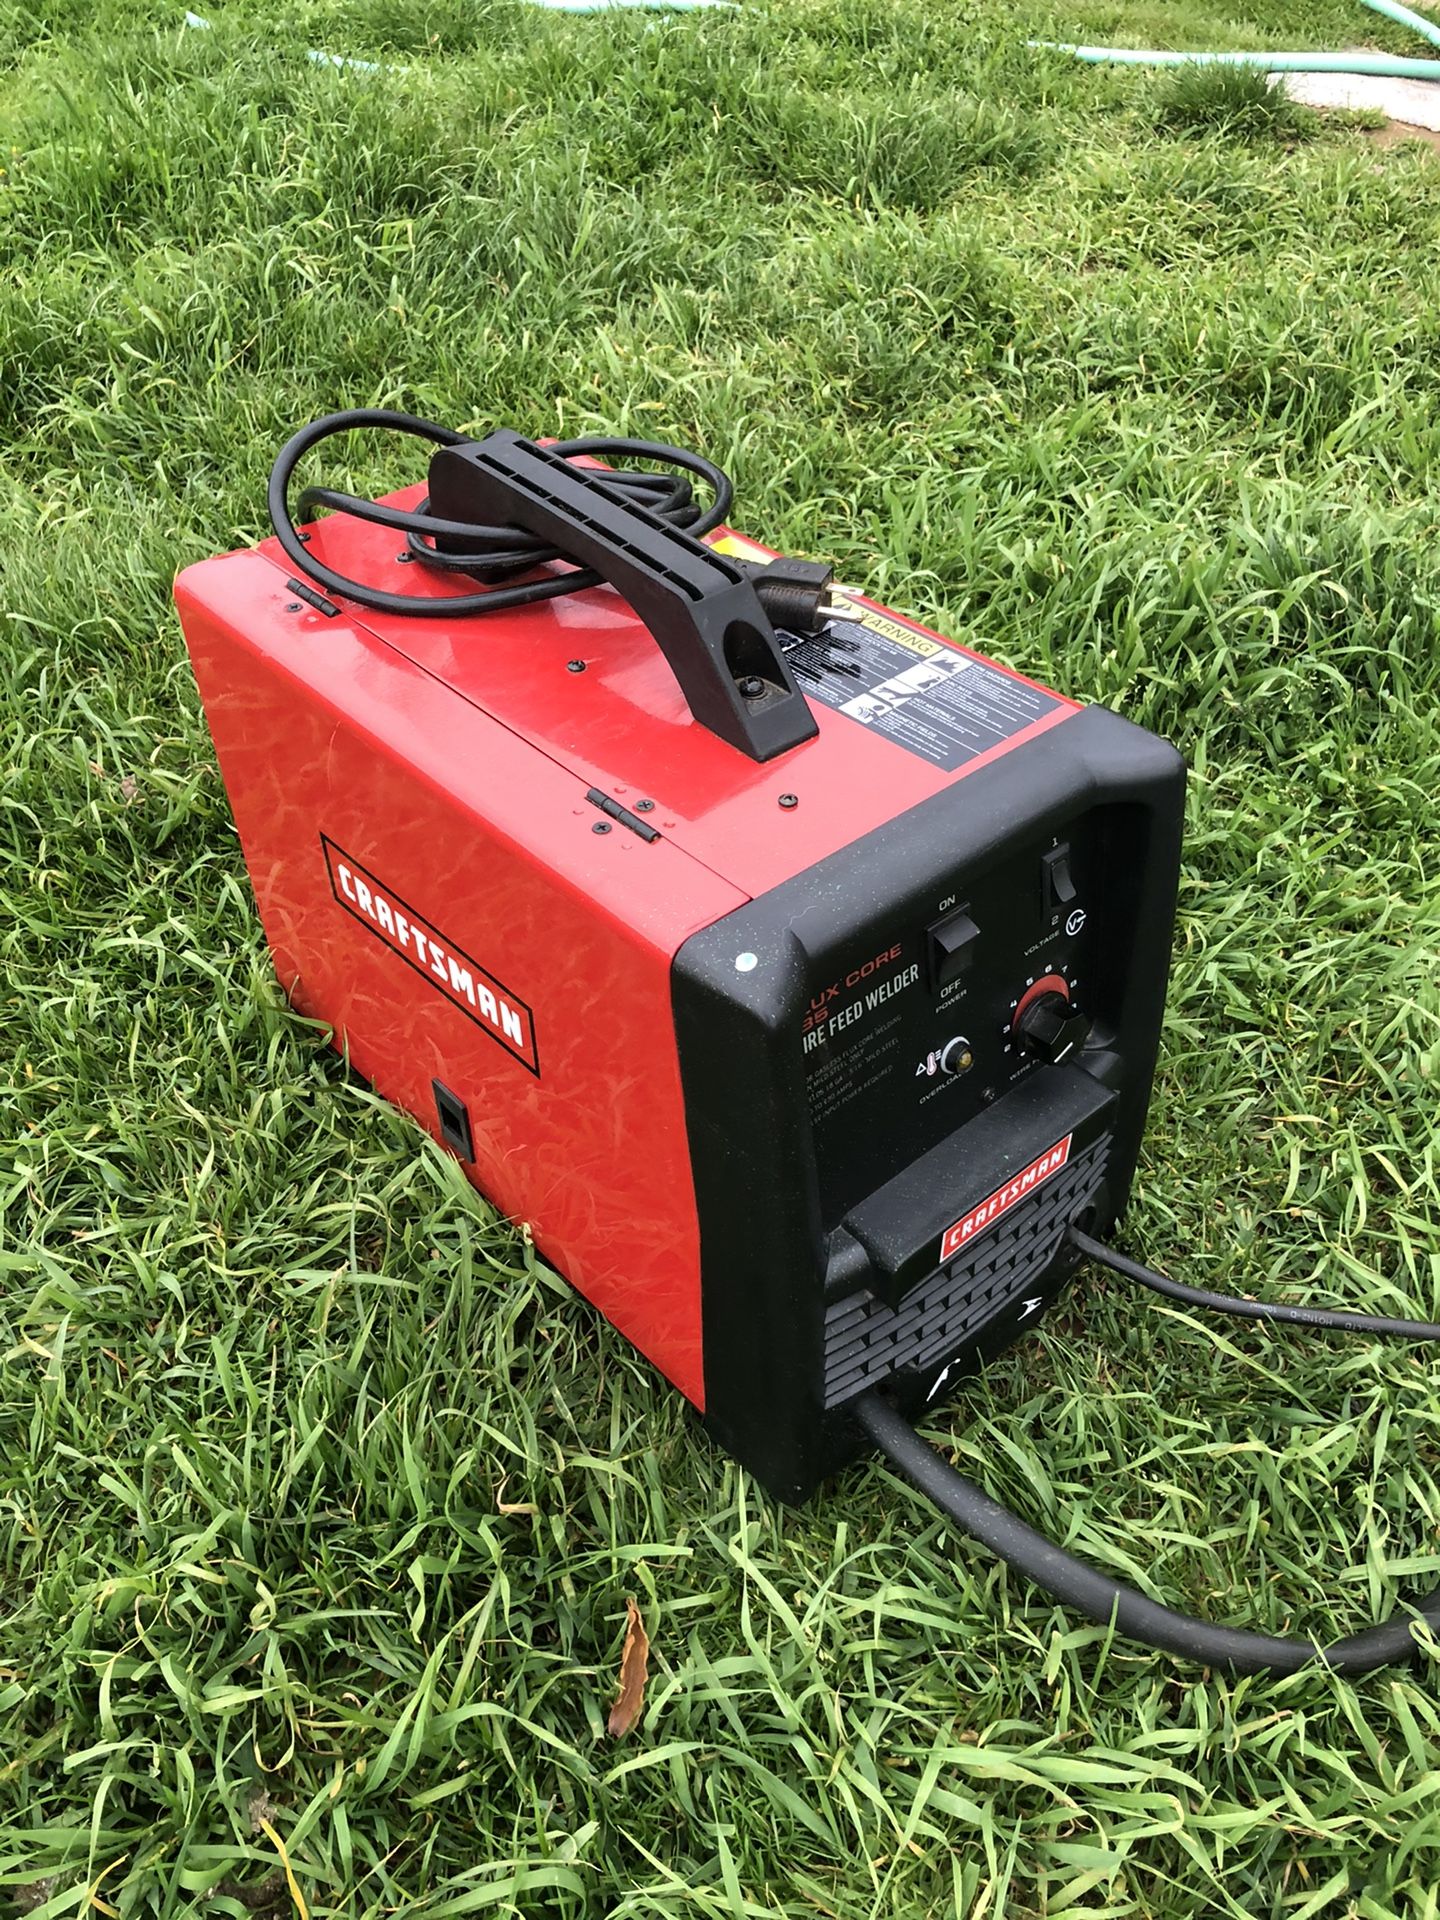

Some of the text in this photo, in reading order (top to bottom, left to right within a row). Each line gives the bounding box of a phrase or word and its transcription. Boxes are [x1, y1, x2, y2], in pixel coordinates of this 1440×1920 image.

[858, 609, 934, 653] WARNING
[1052, 837, 1058, 847] 1
[938, 894, 956, 912] ON
[1052, 915, 1059, 926] 2
[337, 863, 523, 1048] CRAFTSMAN
[1024, 930, 1060, 956] VOLTAGE
[806, 943, 902, 1014] UX CORE
[940, 978, 962, 999] OFF
[802, 964, 919, 1054] IRE FEED WELDER
[935, 988, 967, 1014] POWER
[858, 1032, 874, 1048] CORE
[1009, 1063, 1031, 1081] WIRE
[919, 1072, 963, 1104] OVERLOA
[949, 1147, 1063, 1247] CRAFTSMAN
